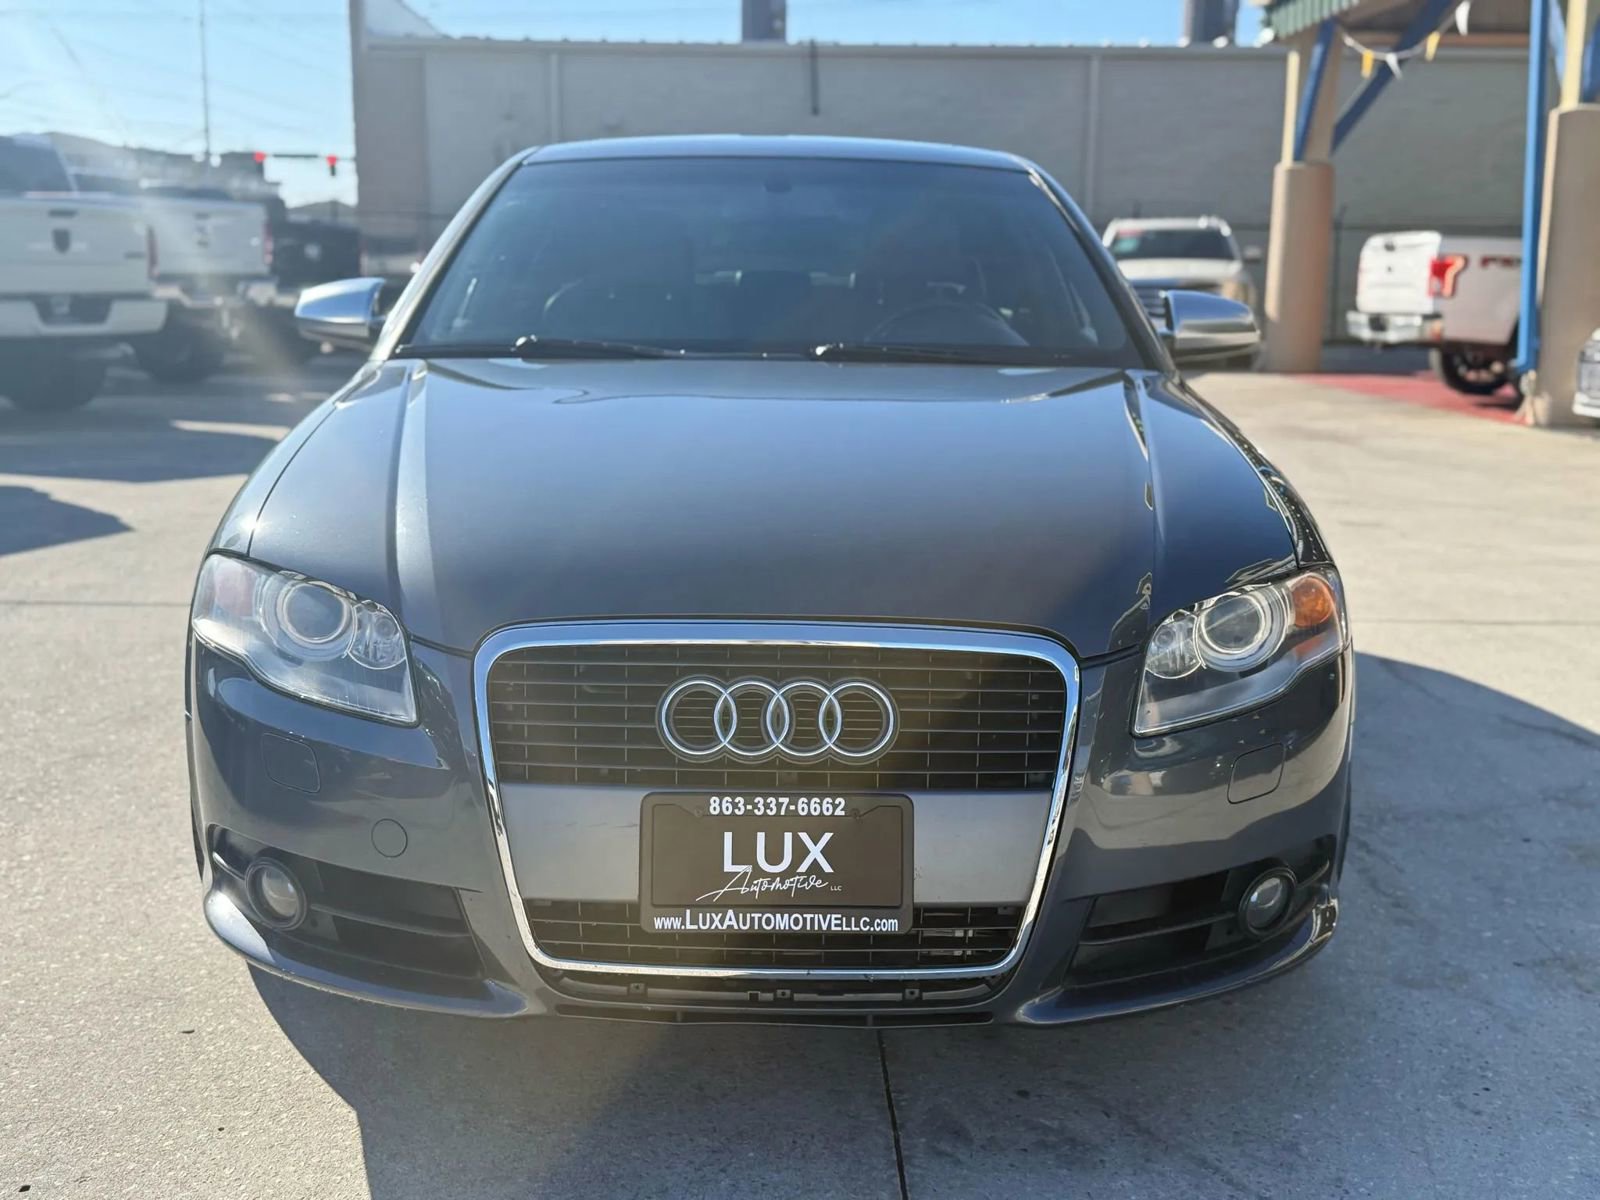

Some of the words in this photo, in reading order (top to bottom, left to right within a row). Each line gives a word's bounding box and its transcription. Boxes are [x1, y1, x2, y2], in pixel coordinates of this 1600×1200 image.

[709, 796, 846, 816] 863-337-6662
[723, 831, 834, 873] LUX
[695, 865, 829, 902] Automotive
